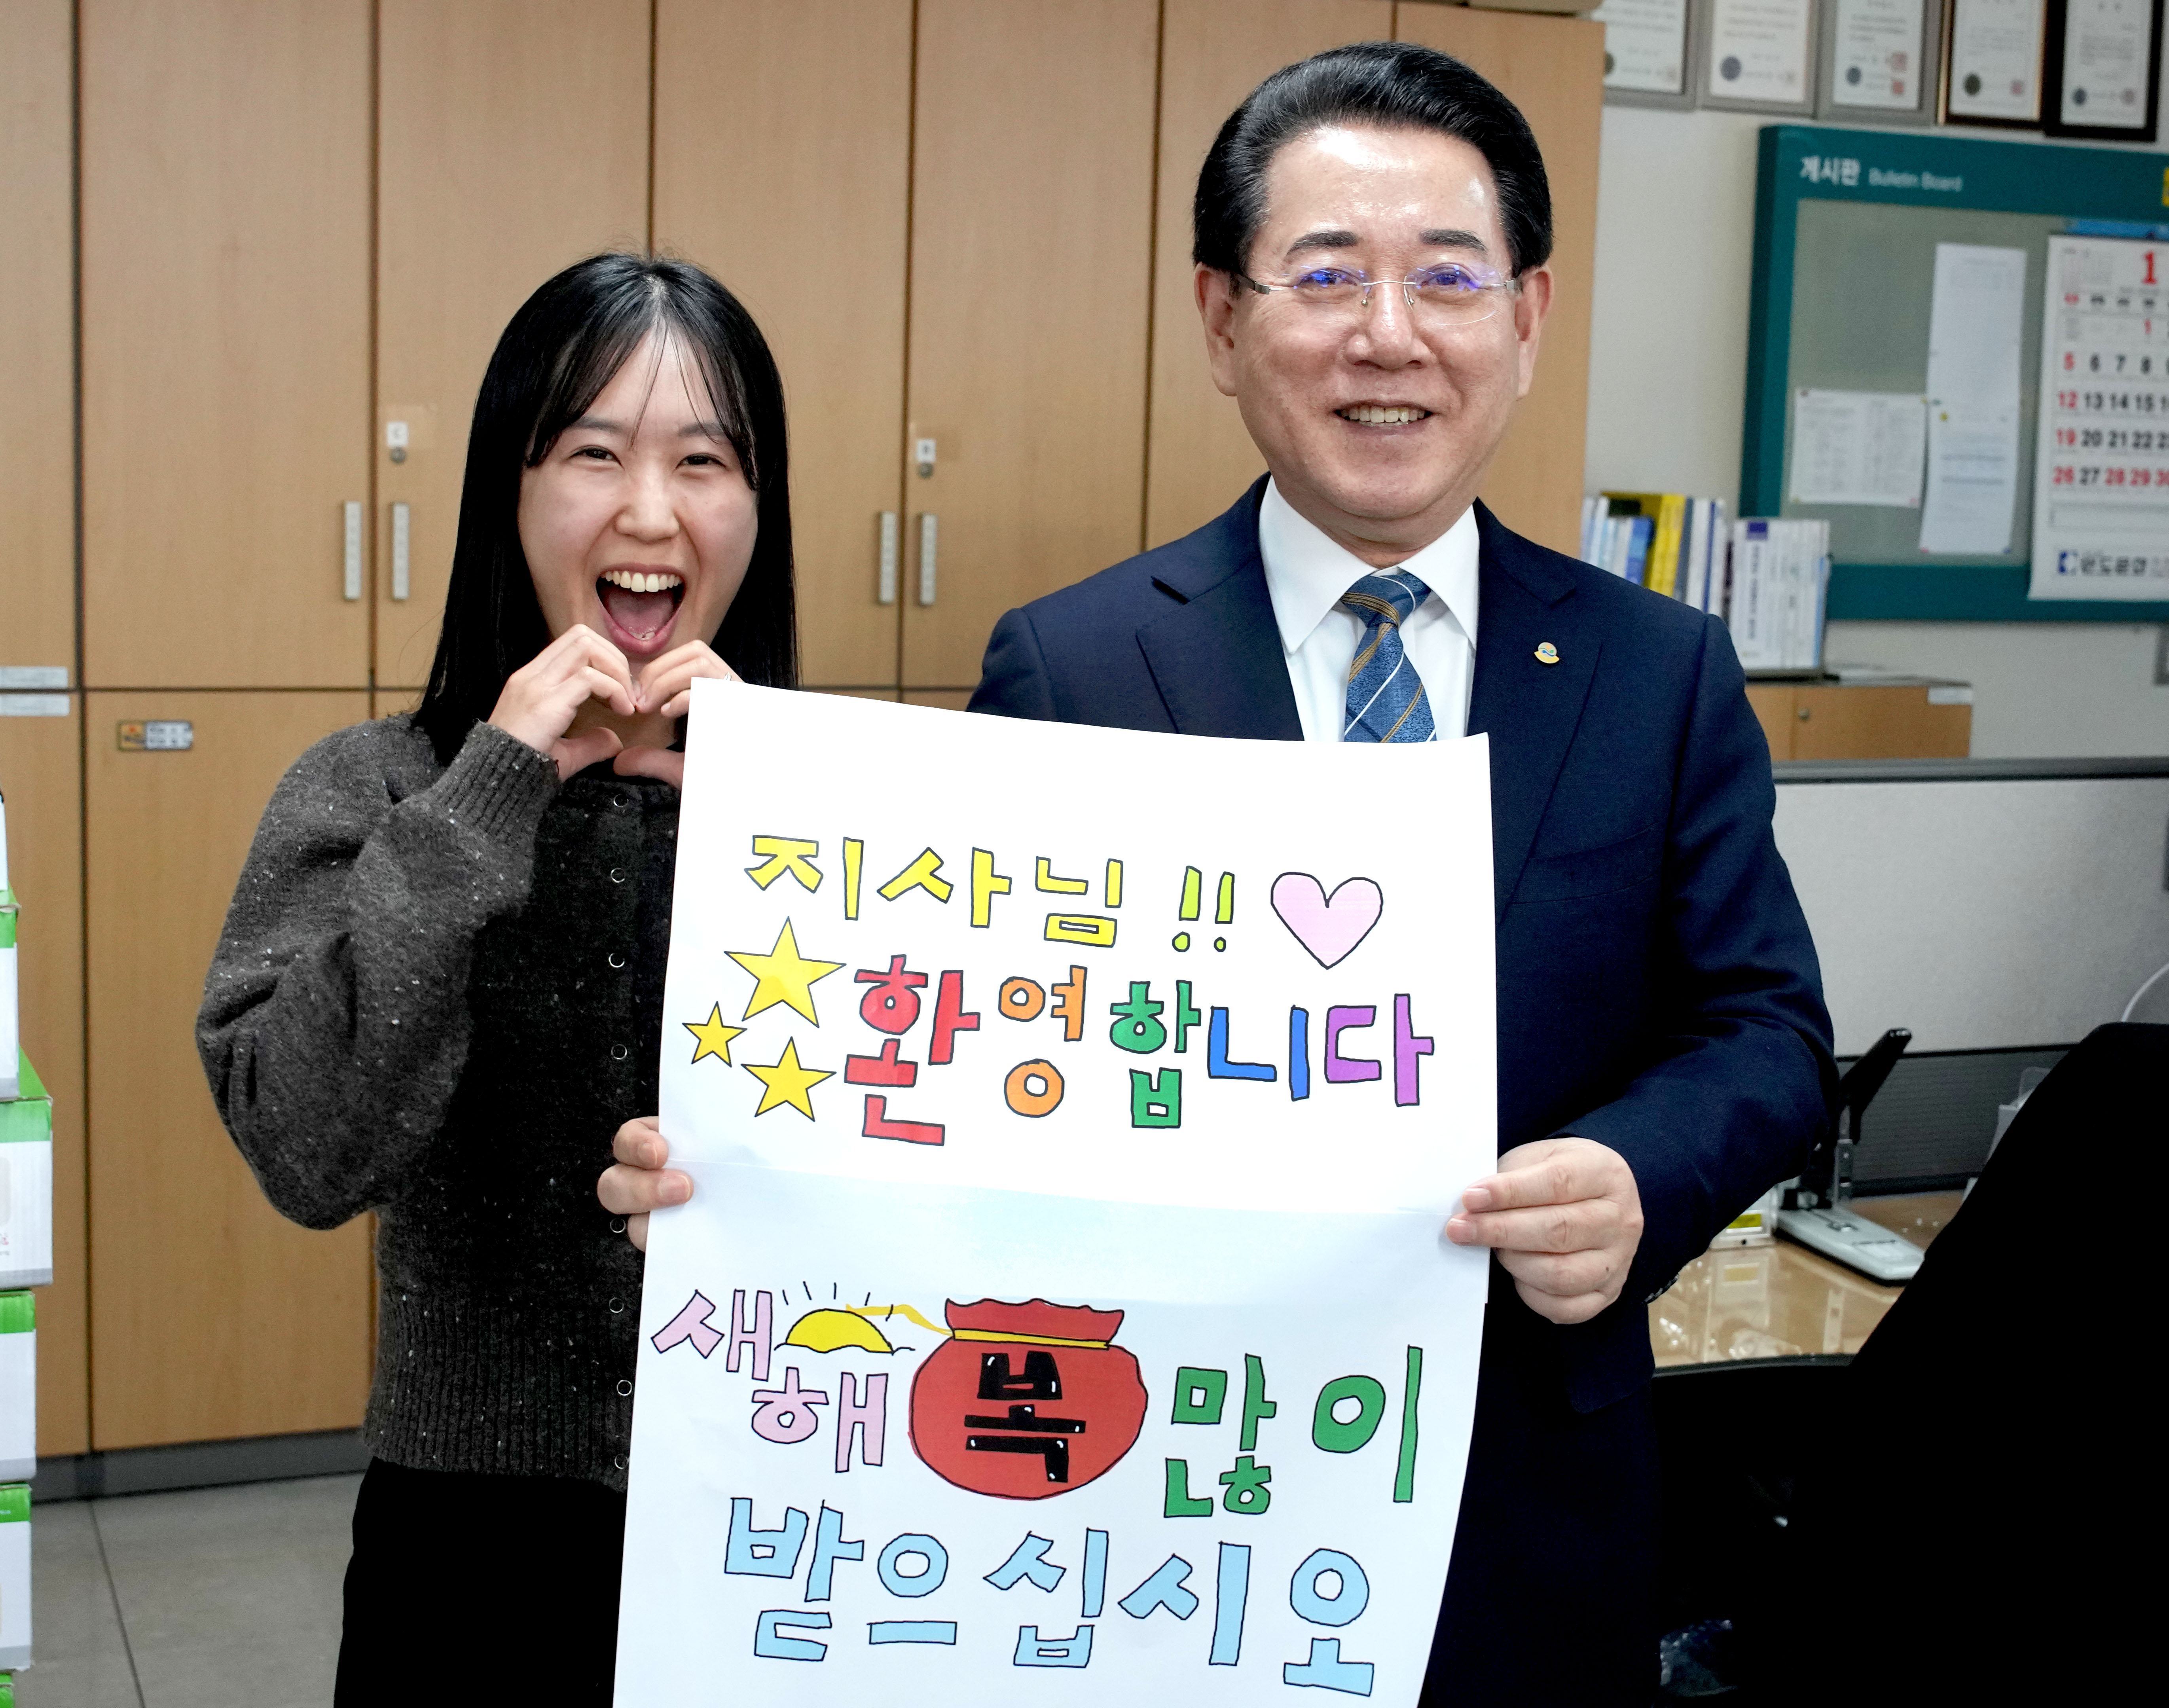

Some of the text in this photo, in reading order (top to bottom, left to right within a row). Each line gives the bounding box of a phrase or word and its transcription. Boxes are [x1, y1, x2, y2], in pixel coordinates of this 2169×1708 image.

[2141, 250, 2157, 285] 1
[2116, 354, 2126, 373] 7
[2058, 391, 2077, 410] 12
[2081, 428, 2103, 447] 20
[2108, 430, 2128, 447] 21
[2132, 430, 2152, 449] 22
[2080, 467, 2100, 486] 27
[745, 835, 1122, 947] 지사님
[844, 954, 1434, 1146] 환영합니다
[650, 1288, 1423, 1518] 새해 복 많이
[724, 1497, 1376, 1697] 받으십시오
